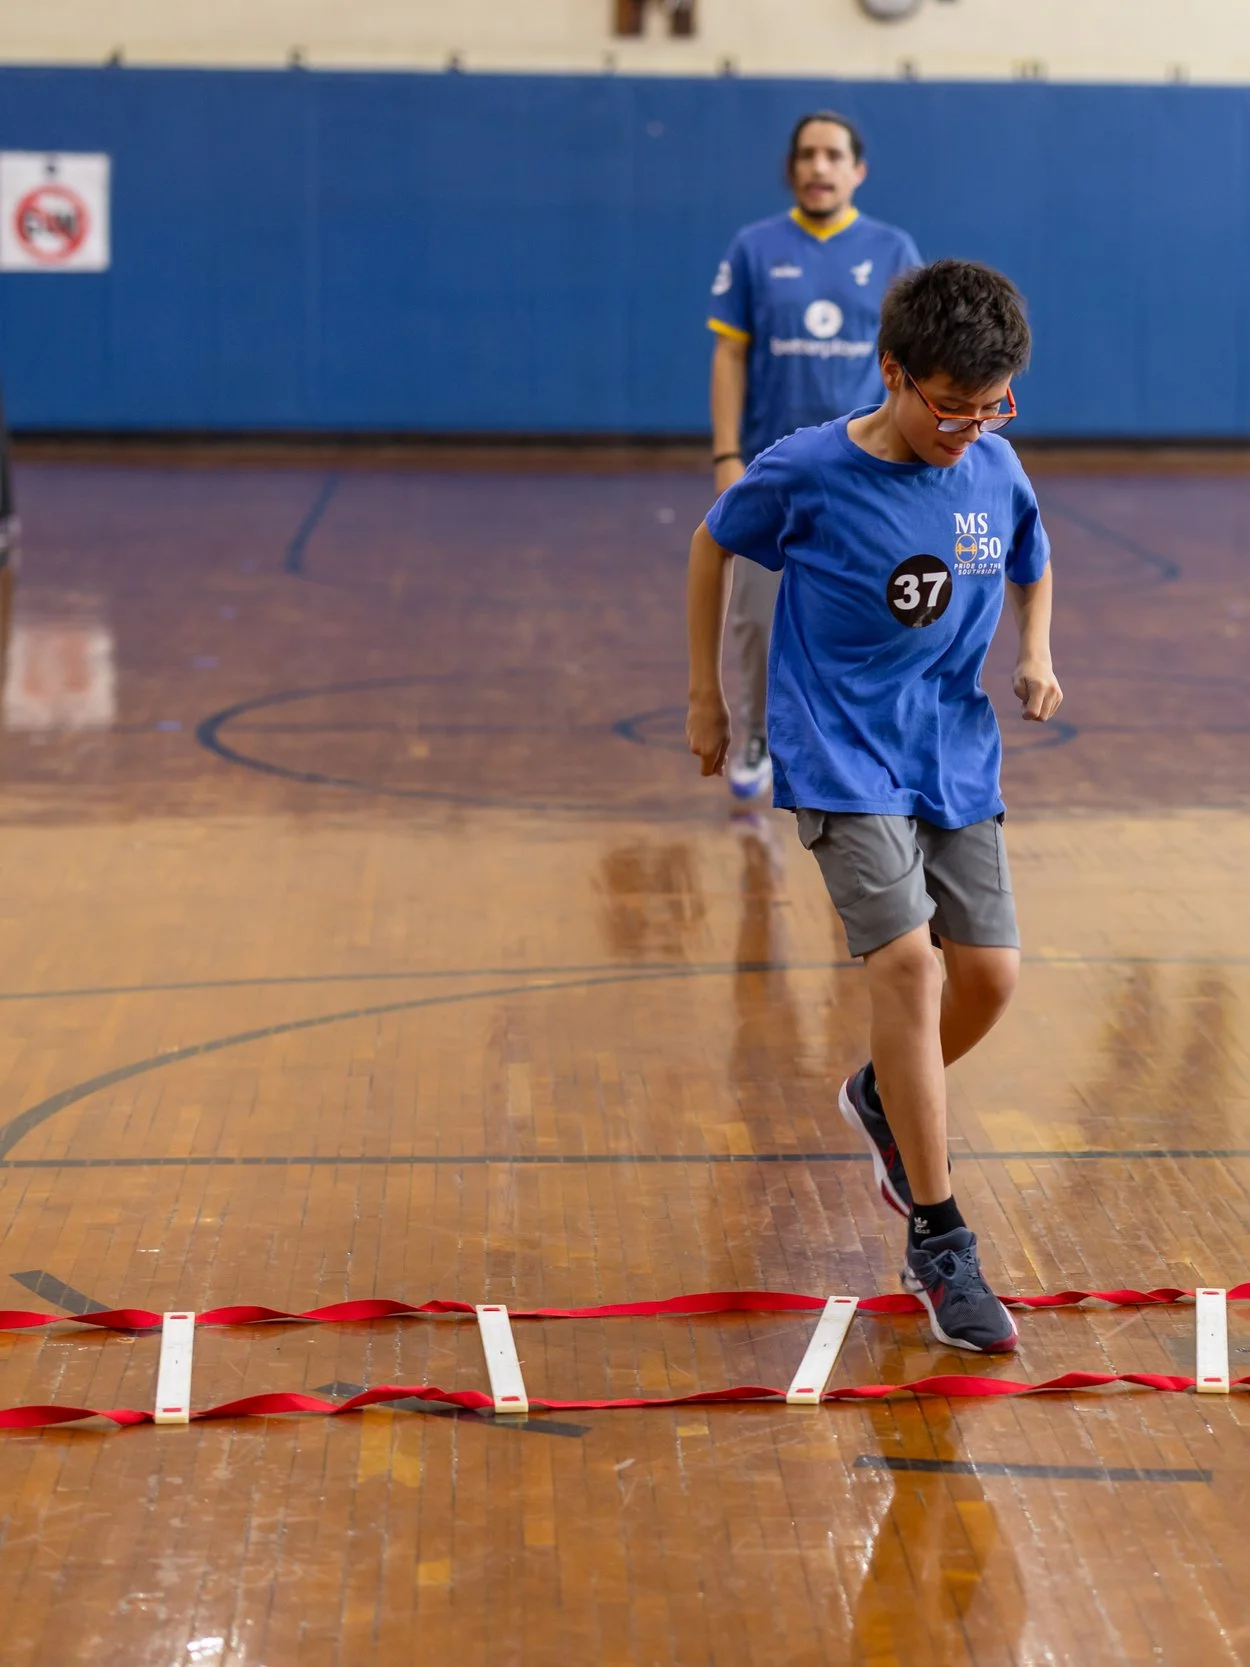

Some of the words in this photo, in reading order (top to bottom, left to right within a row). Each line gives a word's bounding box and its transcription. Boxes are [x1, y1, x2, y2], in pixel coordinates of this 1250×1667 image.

[953, 512, 988, 535] MS
[978, 536, 1002, 561] 50
[954, 562, 976, 570] PRIDE
[978, 562, 988, 570] OF
[893, 571, 948, 610] 37
